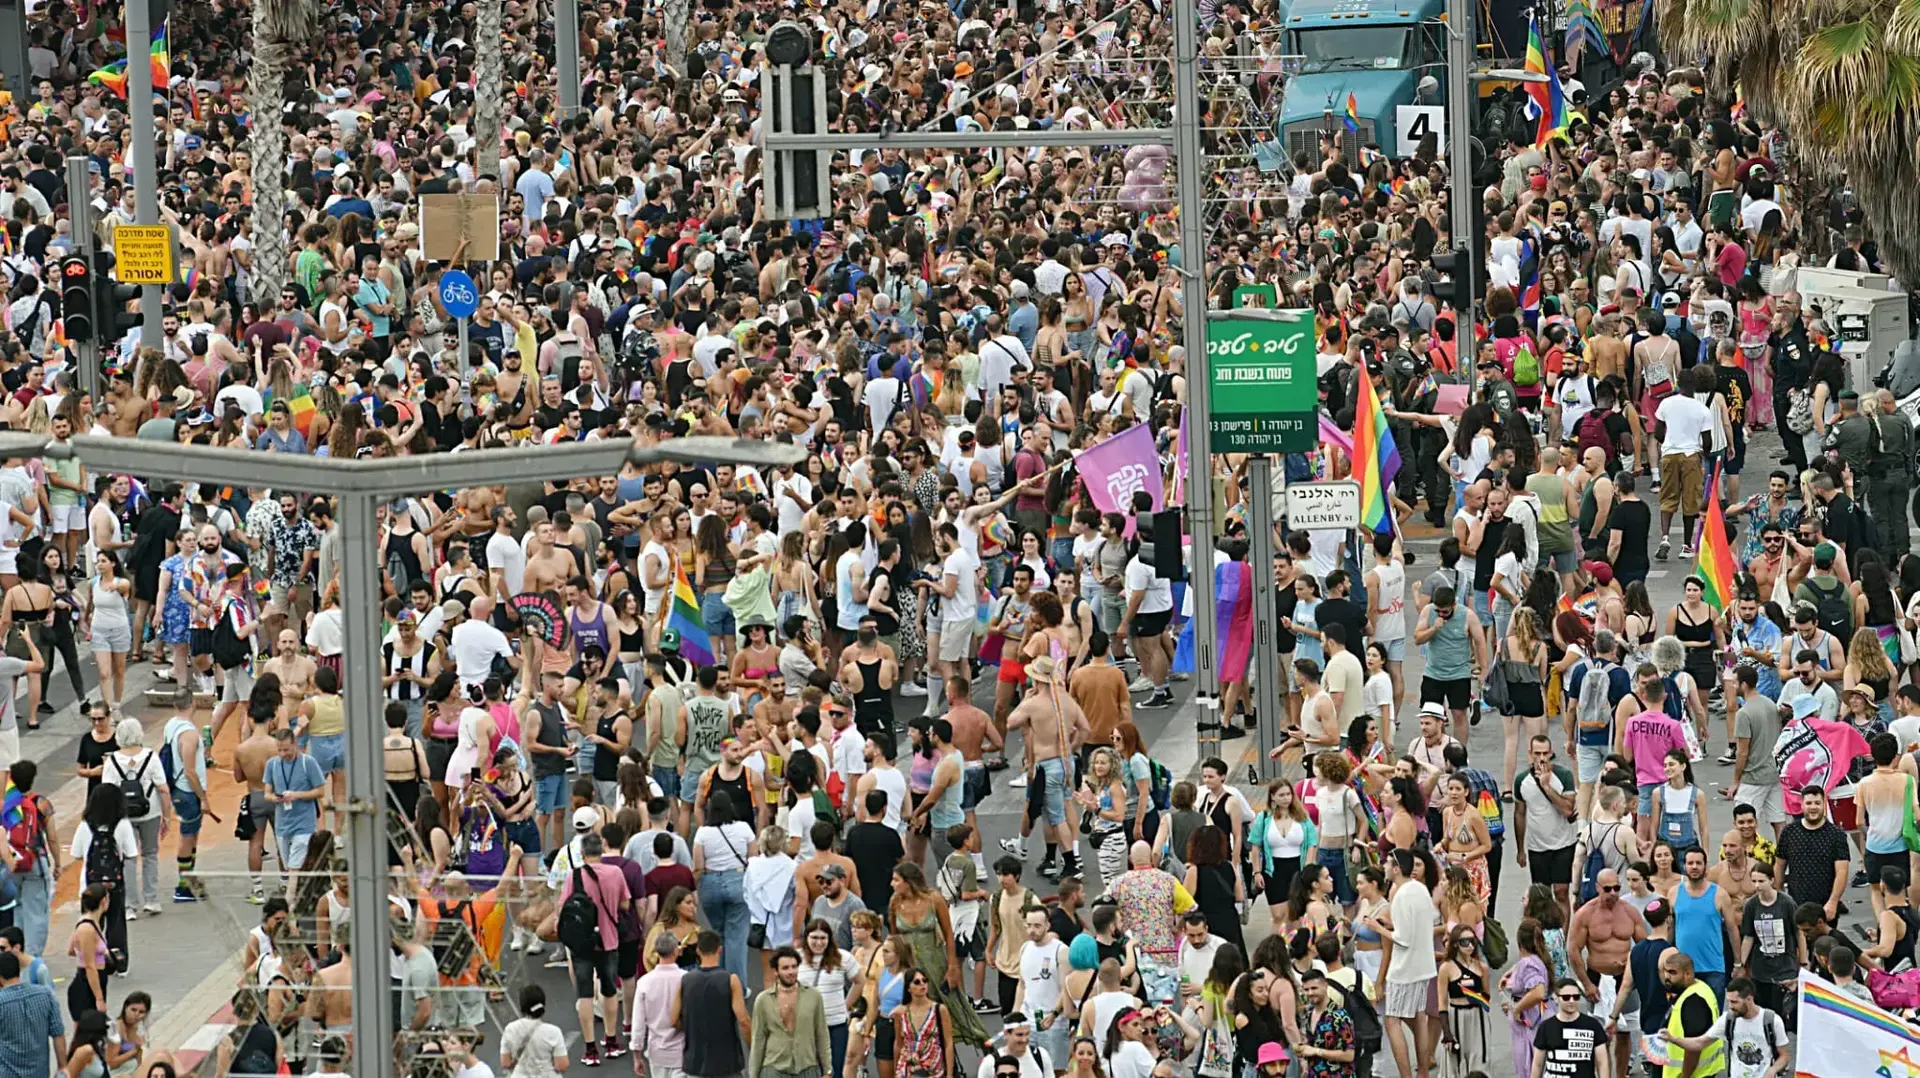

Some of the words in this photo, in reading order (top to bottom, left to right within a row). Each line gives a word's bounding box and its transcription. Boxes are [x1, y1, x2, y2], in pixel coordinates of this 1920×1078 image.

[1407, 112, 1432, 142] 4
[118, 230, 143, 238] מדרכה
[145, 230, 165, 238] שטח
[124, 269, 163, 279] אסורה
[1263, 332, 1305, 354] טיב
[1215, 368, 1233, 381] וחג
[1234, 367, 1265, 381] בשבת
[1266, 367, 1292, 380] פתוח
[1220, 420, 1252, 433] פרישמן
[1268, 420, 1292, 431] יהודה
[1293, 419, 1304, 431] בן
[1230, 434, 1246, 445] 130
[1247, 434, 1272, 445] יהודה
[1273, 434, 1283, 446] בן
[1292, 487, 1334, 499] אלנבי
[1293, 514, 1341, 524] ALLENBY
[1632, 721, 1671, 738] DENIM
